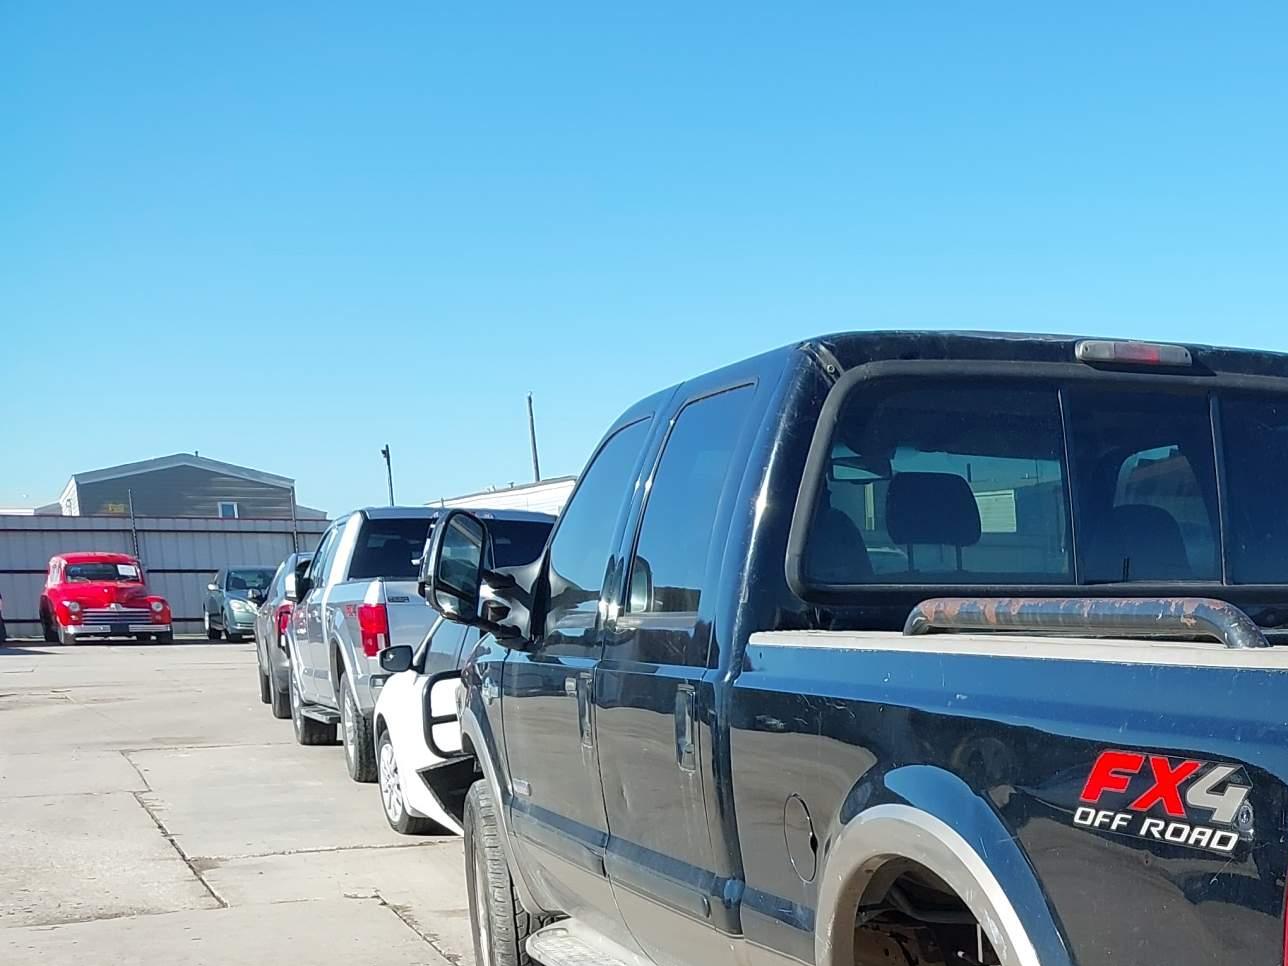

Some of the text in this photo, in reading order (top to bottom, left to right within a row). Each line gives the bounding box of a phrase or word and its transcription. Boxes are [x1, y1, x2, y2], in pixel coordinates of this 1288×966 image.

[1079, 750, 1252, 824] FX4
[1073, 807, 1240, 851] OFF ROAD
